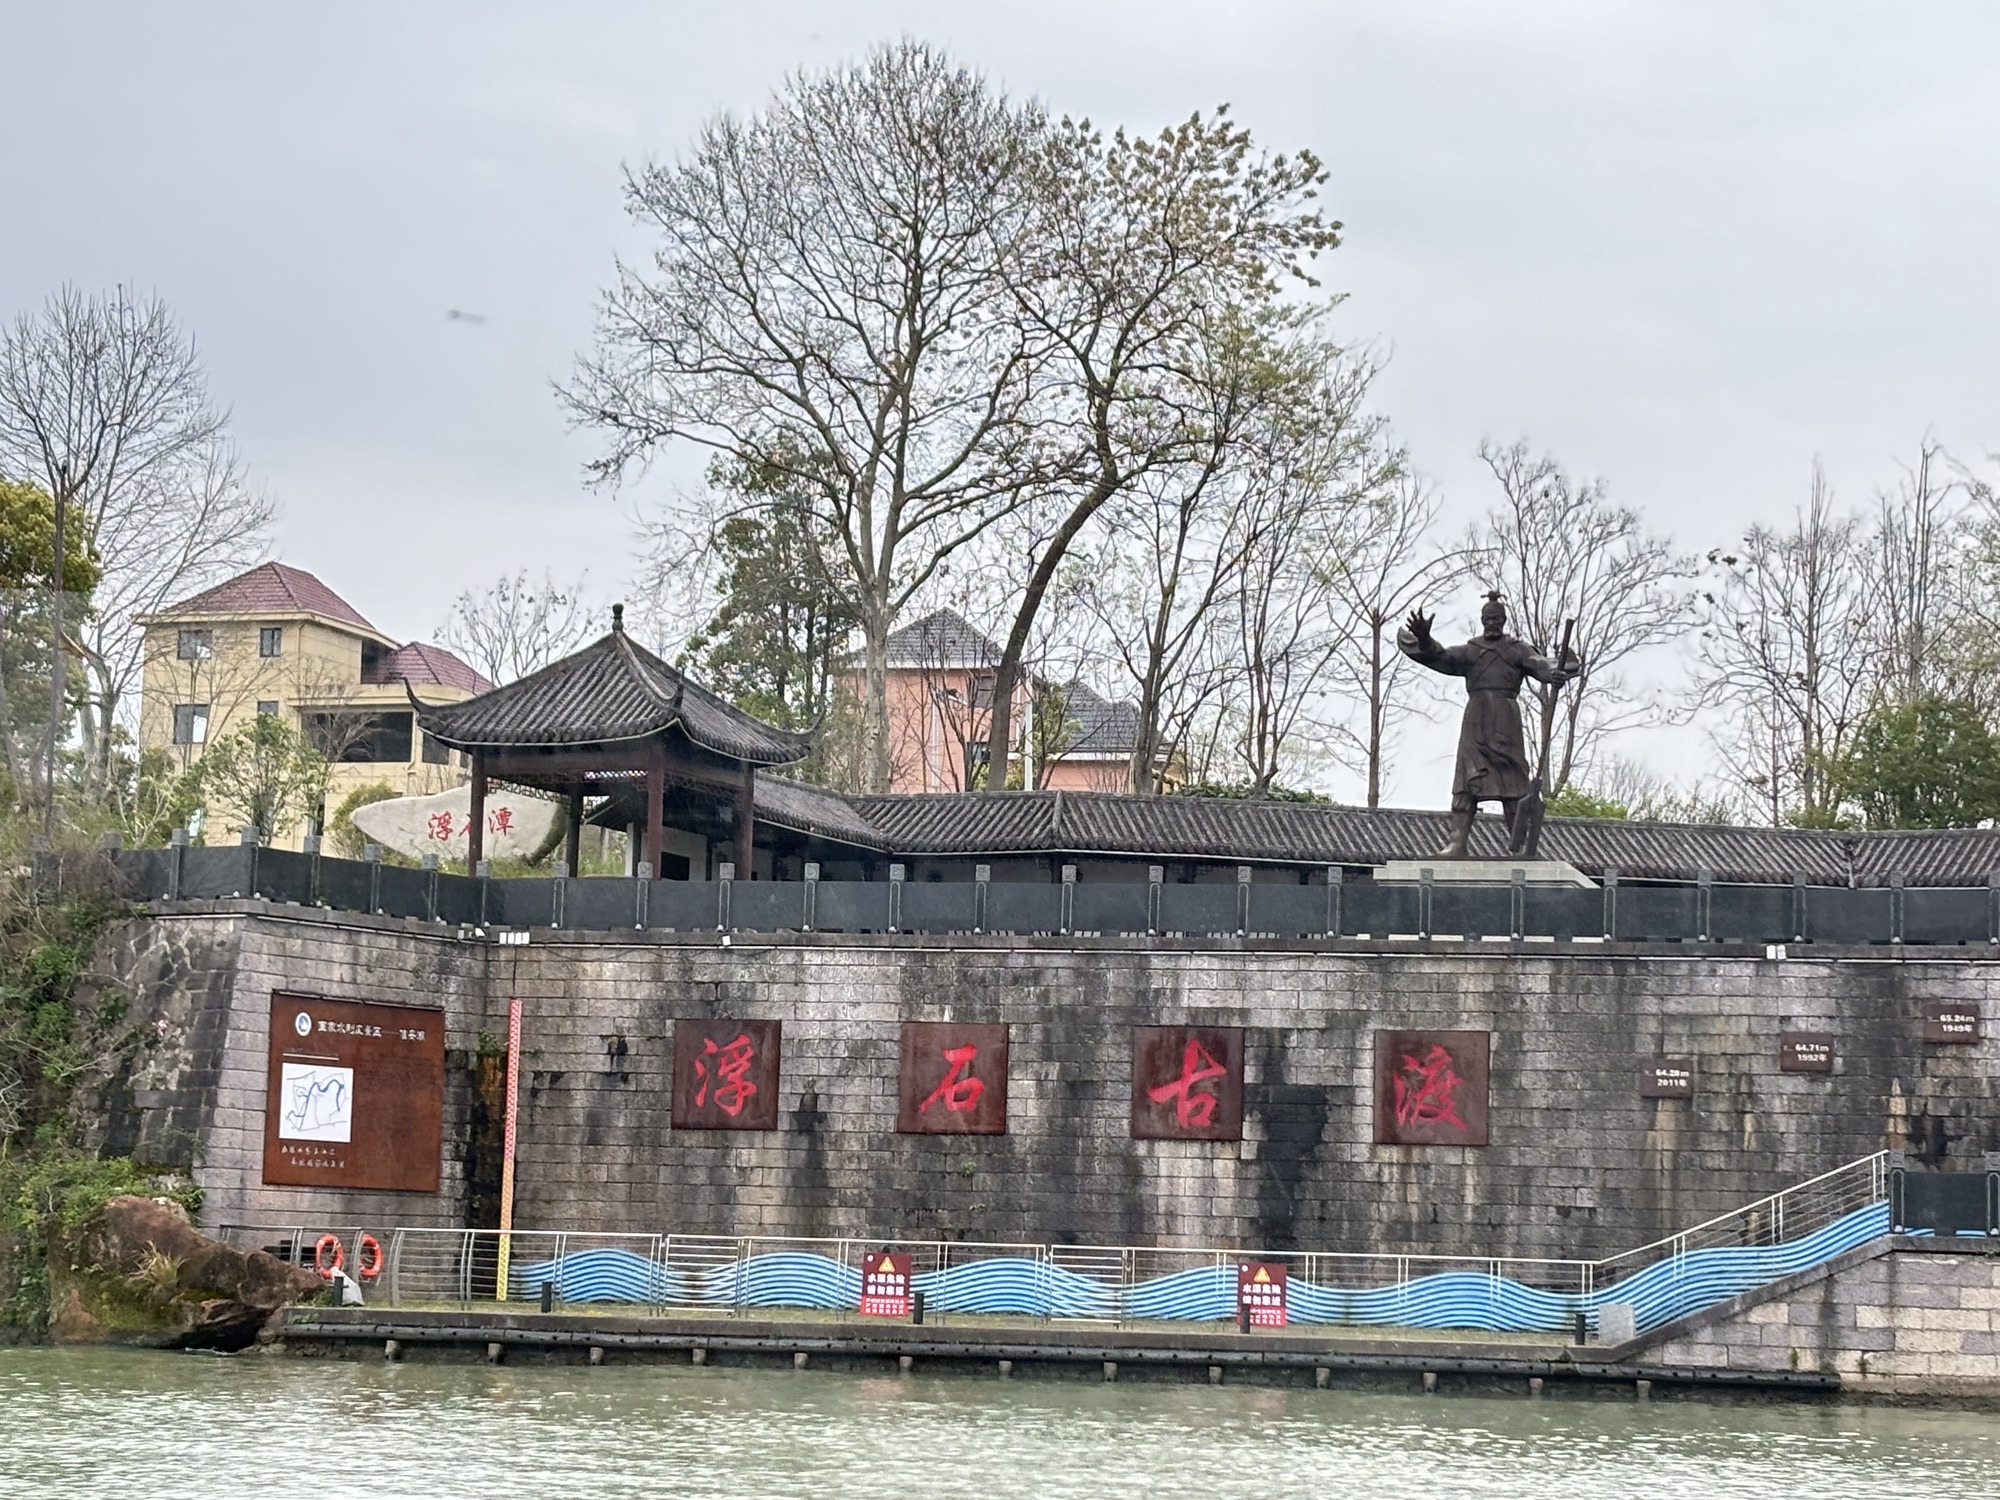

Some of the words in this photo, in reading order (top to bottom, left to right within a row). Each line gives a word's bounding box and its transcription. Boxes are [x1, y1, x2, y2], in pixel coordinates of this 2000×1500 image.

[694, 1033, 757, 1117] 浮
[919, 1044, 985, 1114] 石
[1147, 1039, 1228, 1129] 古
[1392, 1044, 1468, 1132] 渡
